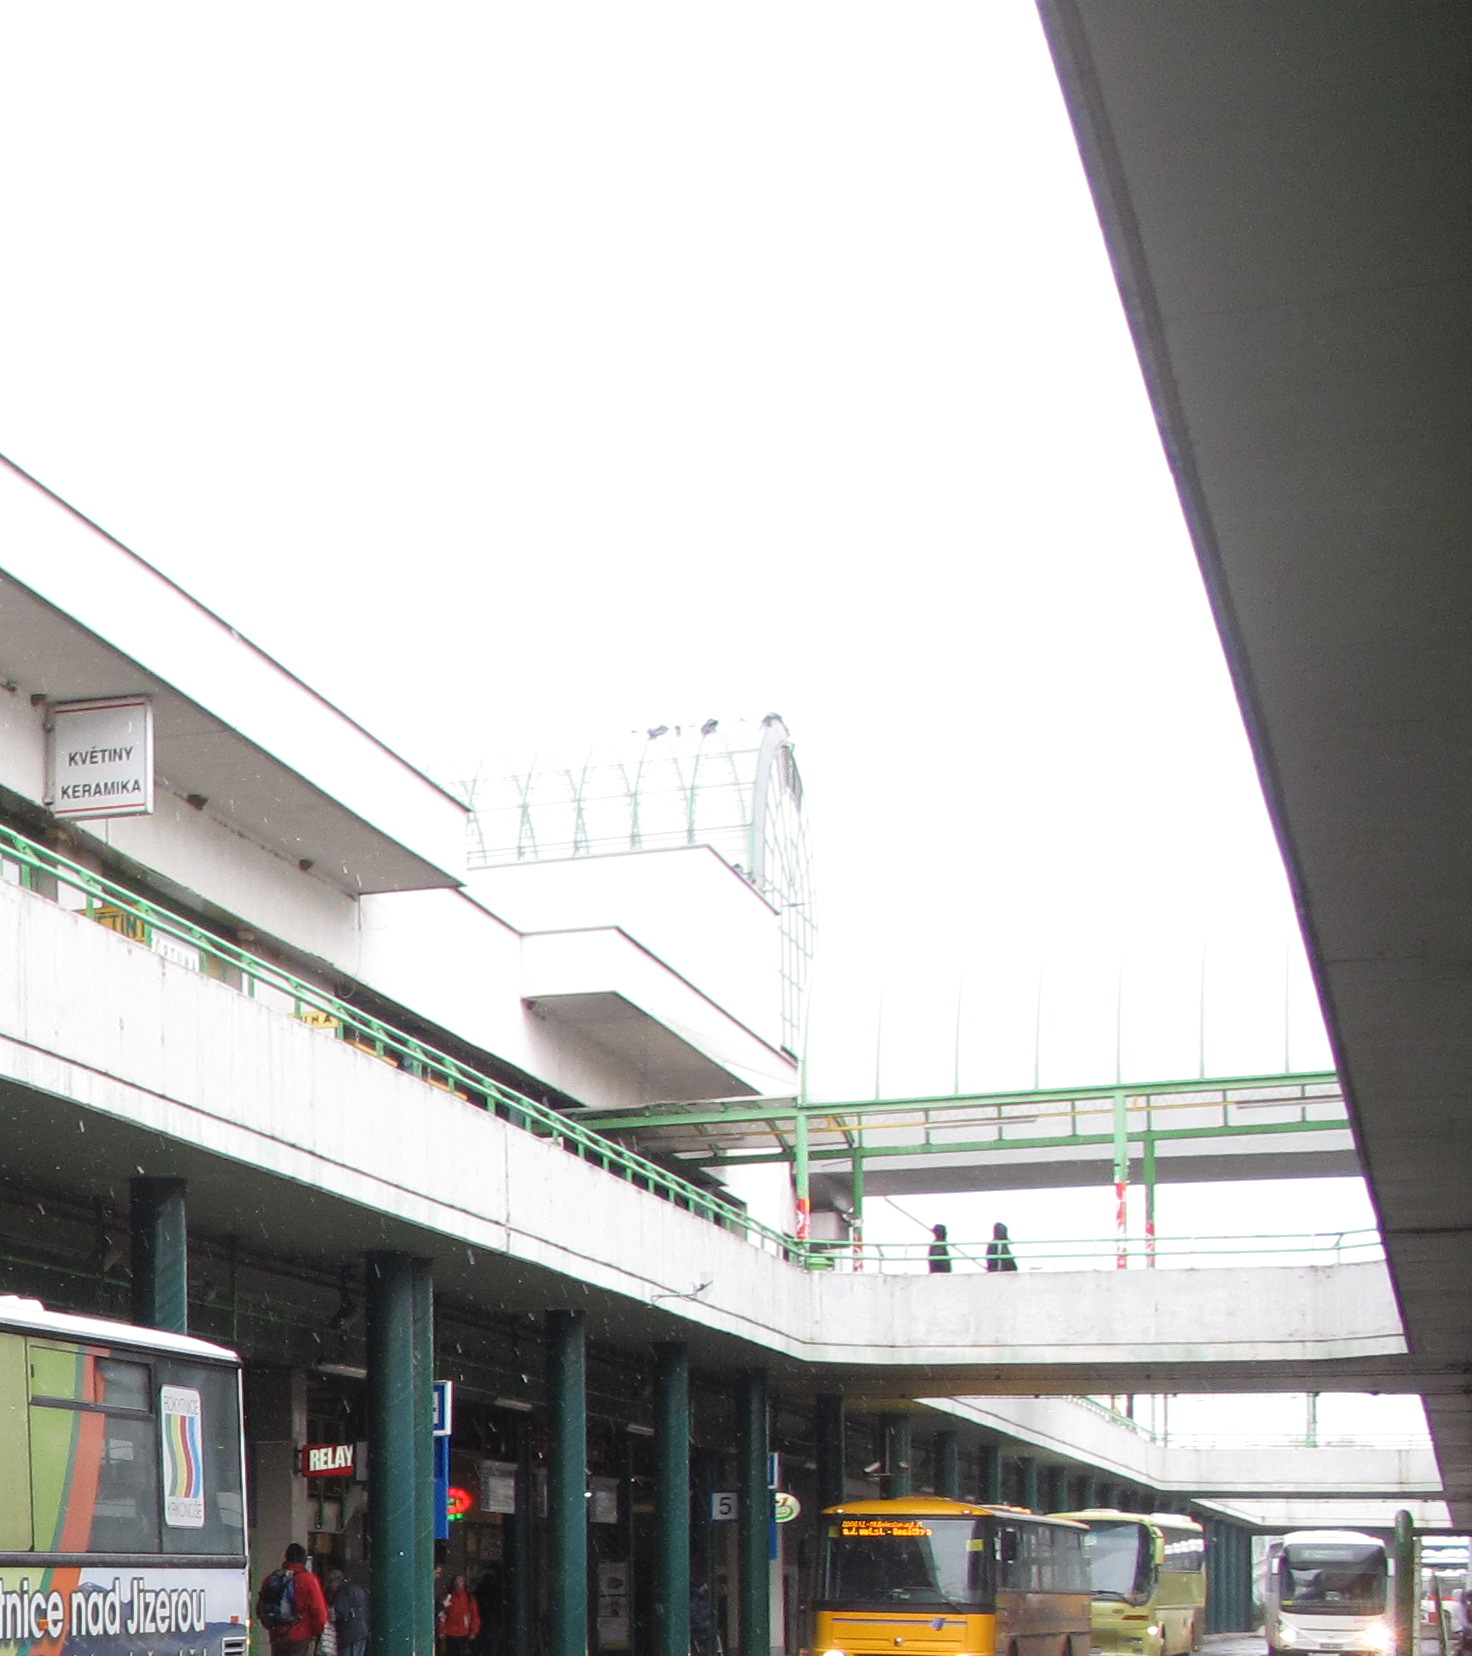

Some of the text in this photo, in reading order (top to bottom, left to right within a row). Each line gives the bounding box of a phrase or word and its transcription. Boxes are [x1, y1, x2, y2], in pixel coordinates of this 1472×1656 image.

[61, 779, 142, 800] KERAMIKA
[309, 1445, 354, 1472] RELAY
[719, 1496, 732, 1515] 5
[70, 1577, 121, 1637] nad
[127, 1577, 206, 1635] Jizerou
